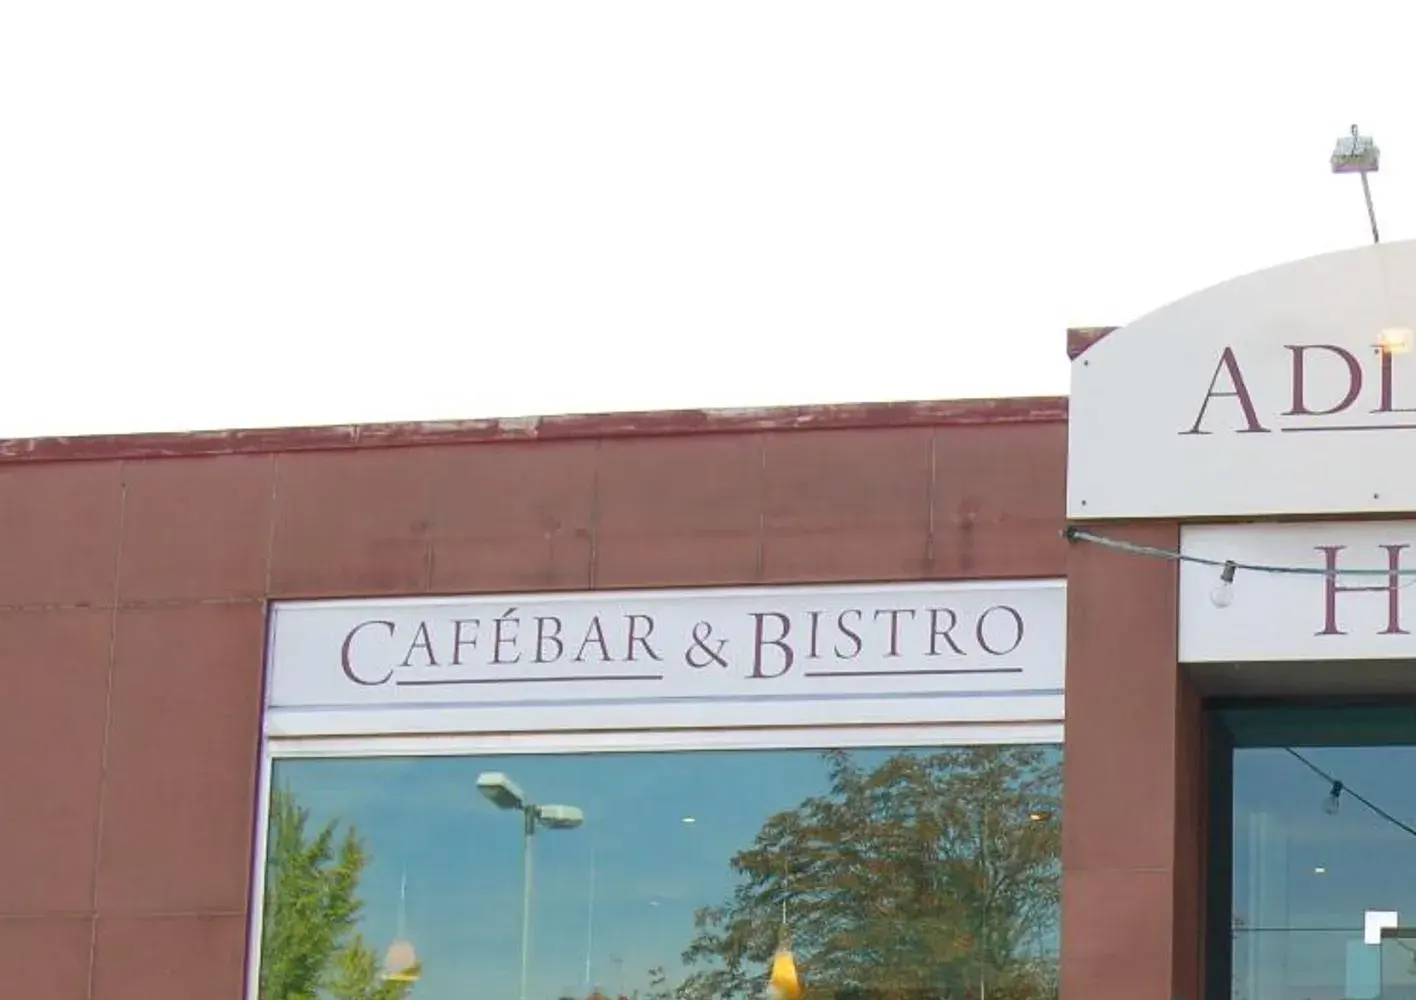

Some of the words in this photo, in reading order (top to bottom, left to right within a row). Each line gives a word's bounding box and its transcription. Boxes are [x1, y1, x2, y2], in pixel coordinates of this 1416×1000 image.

[339, 607, 664, 687] CAFÉBAR
[684, 620, 730, 669] &
[746, 605, 1025, 679] BISTRO
